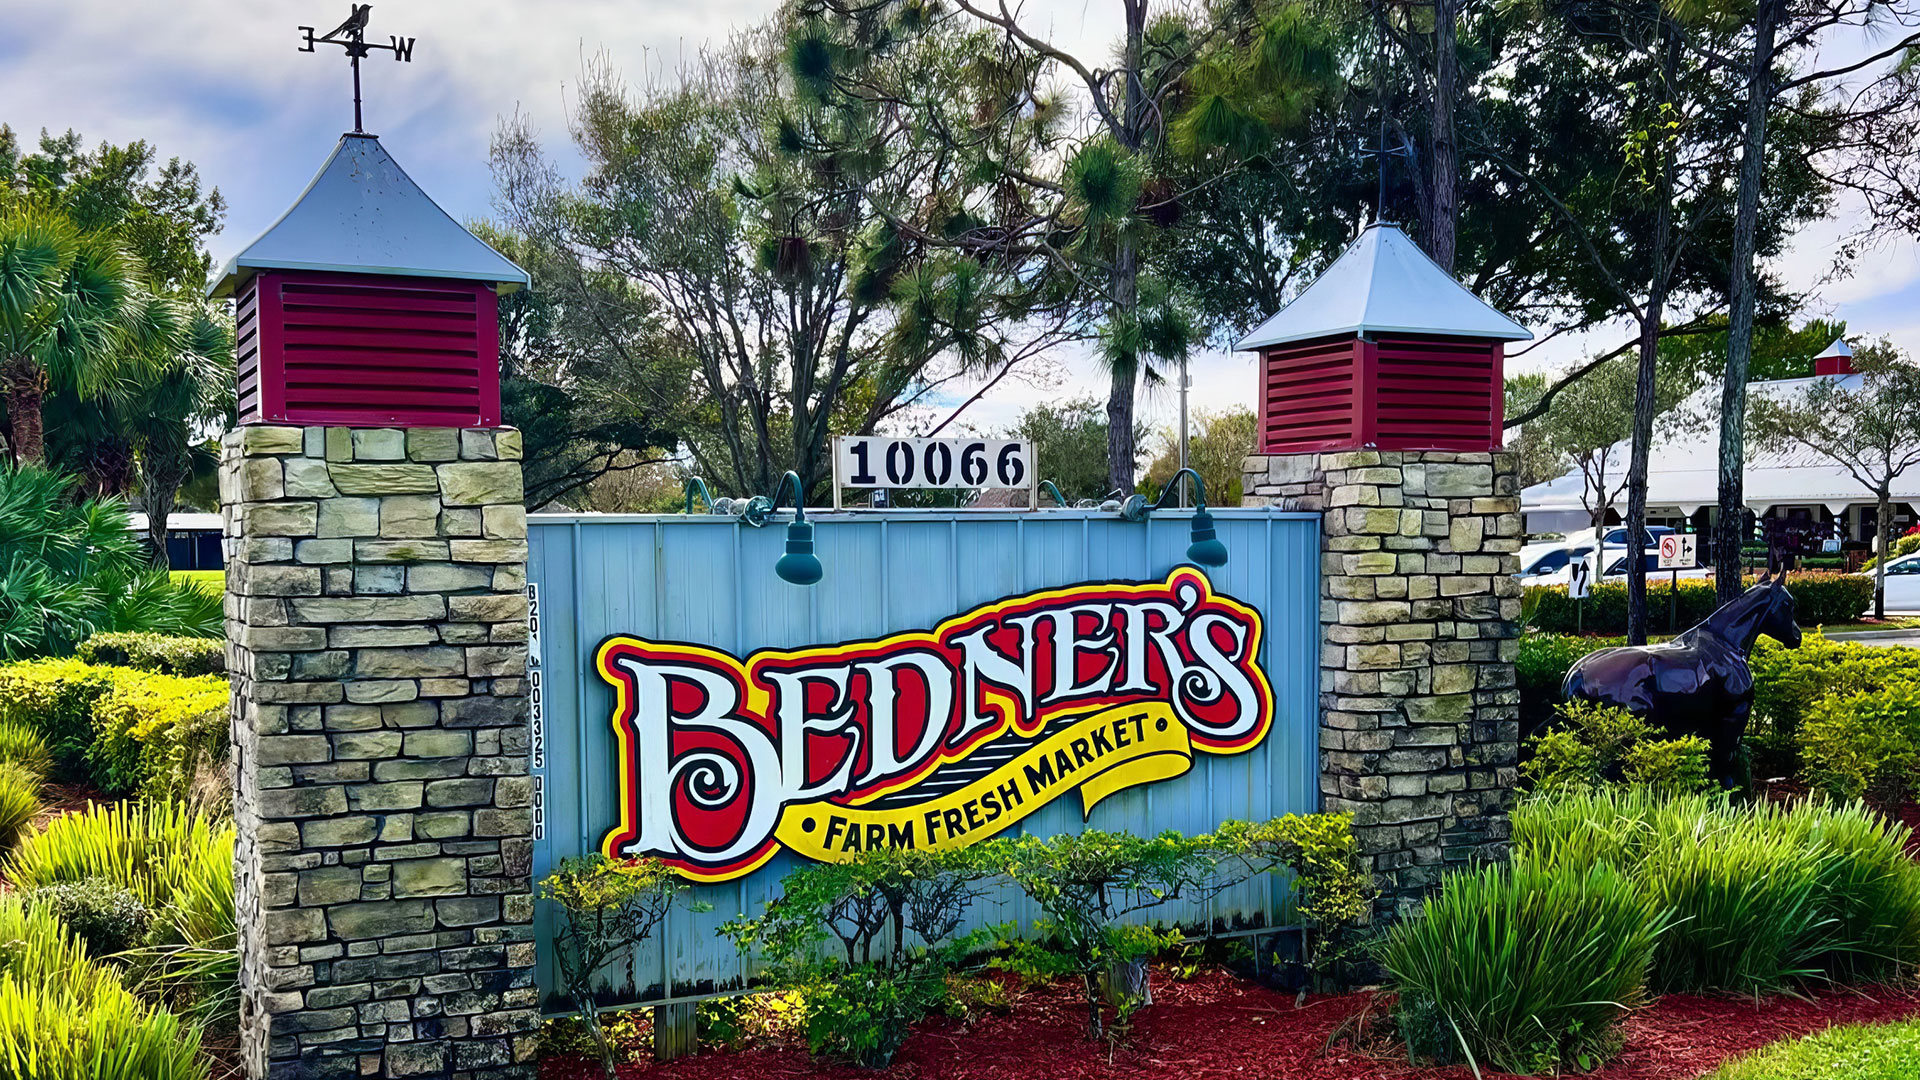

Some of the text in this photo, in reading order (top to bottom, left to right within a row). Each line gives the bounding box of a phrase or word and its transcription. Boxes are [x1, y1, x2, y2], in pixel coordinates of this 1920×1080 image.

[389, 35, 416, 62] W
[850, 441, 1024, 486] 10066
[614, 584, 1249, 862] BEDNER'S
[824, 712, 1149, 851] FARM FRESH MARKET
